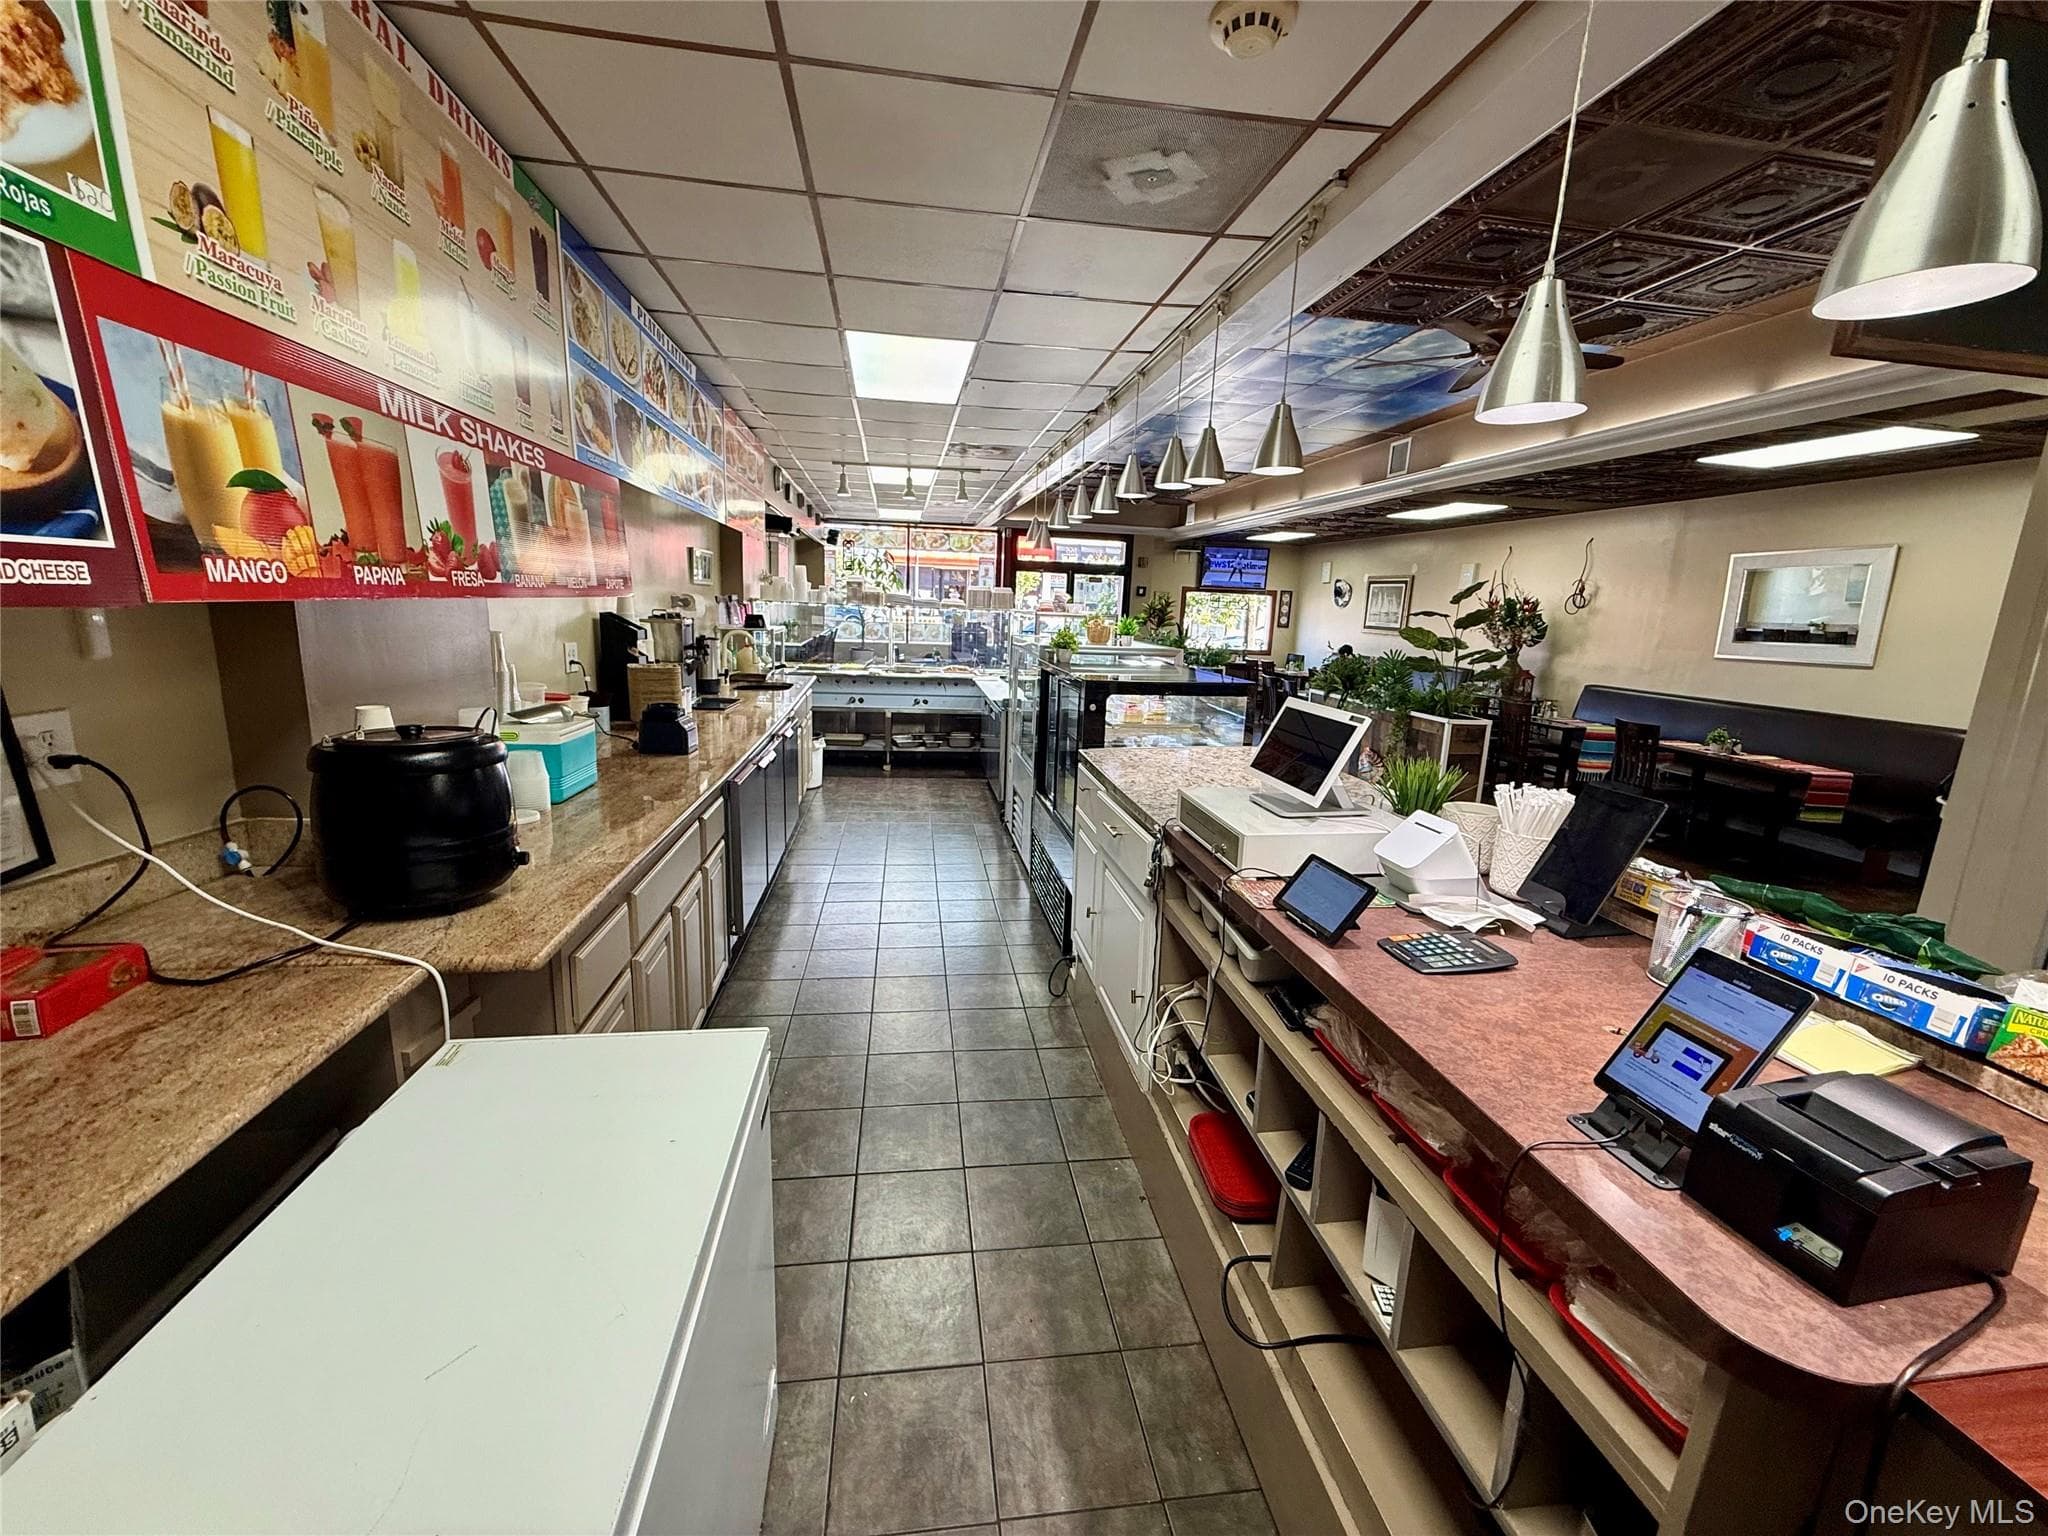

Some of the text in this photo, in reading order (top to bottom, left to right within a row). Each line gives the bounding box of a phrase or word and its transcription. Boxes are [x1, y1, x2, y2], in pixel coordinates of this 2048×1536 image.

[139, 0, 234, 87] Tamarind
[288, 96, 320, 134] Piña
[427, 69, 510, 178] DRINKS
[371, 165, 406, 201] Nance
[199, 235, 282, 290] Maracuya
[259, 289, 296, 318] Fruit
[377, 383, 455, 438] MILK
[459, 417, 547, 470] SHAKES
[18, 563, 88, 580] CHEESE
[204, 557, 288, 584] MANGO
[353, 565, 406, 586] PAPAYA
[451, 570, 485, 587] FRESA
[515, 574, 546, 588] BANANA
[1780, 932, 1824, 955] 10 PACKS
[1882, 973, 1939, 1000] 10 PACKS
